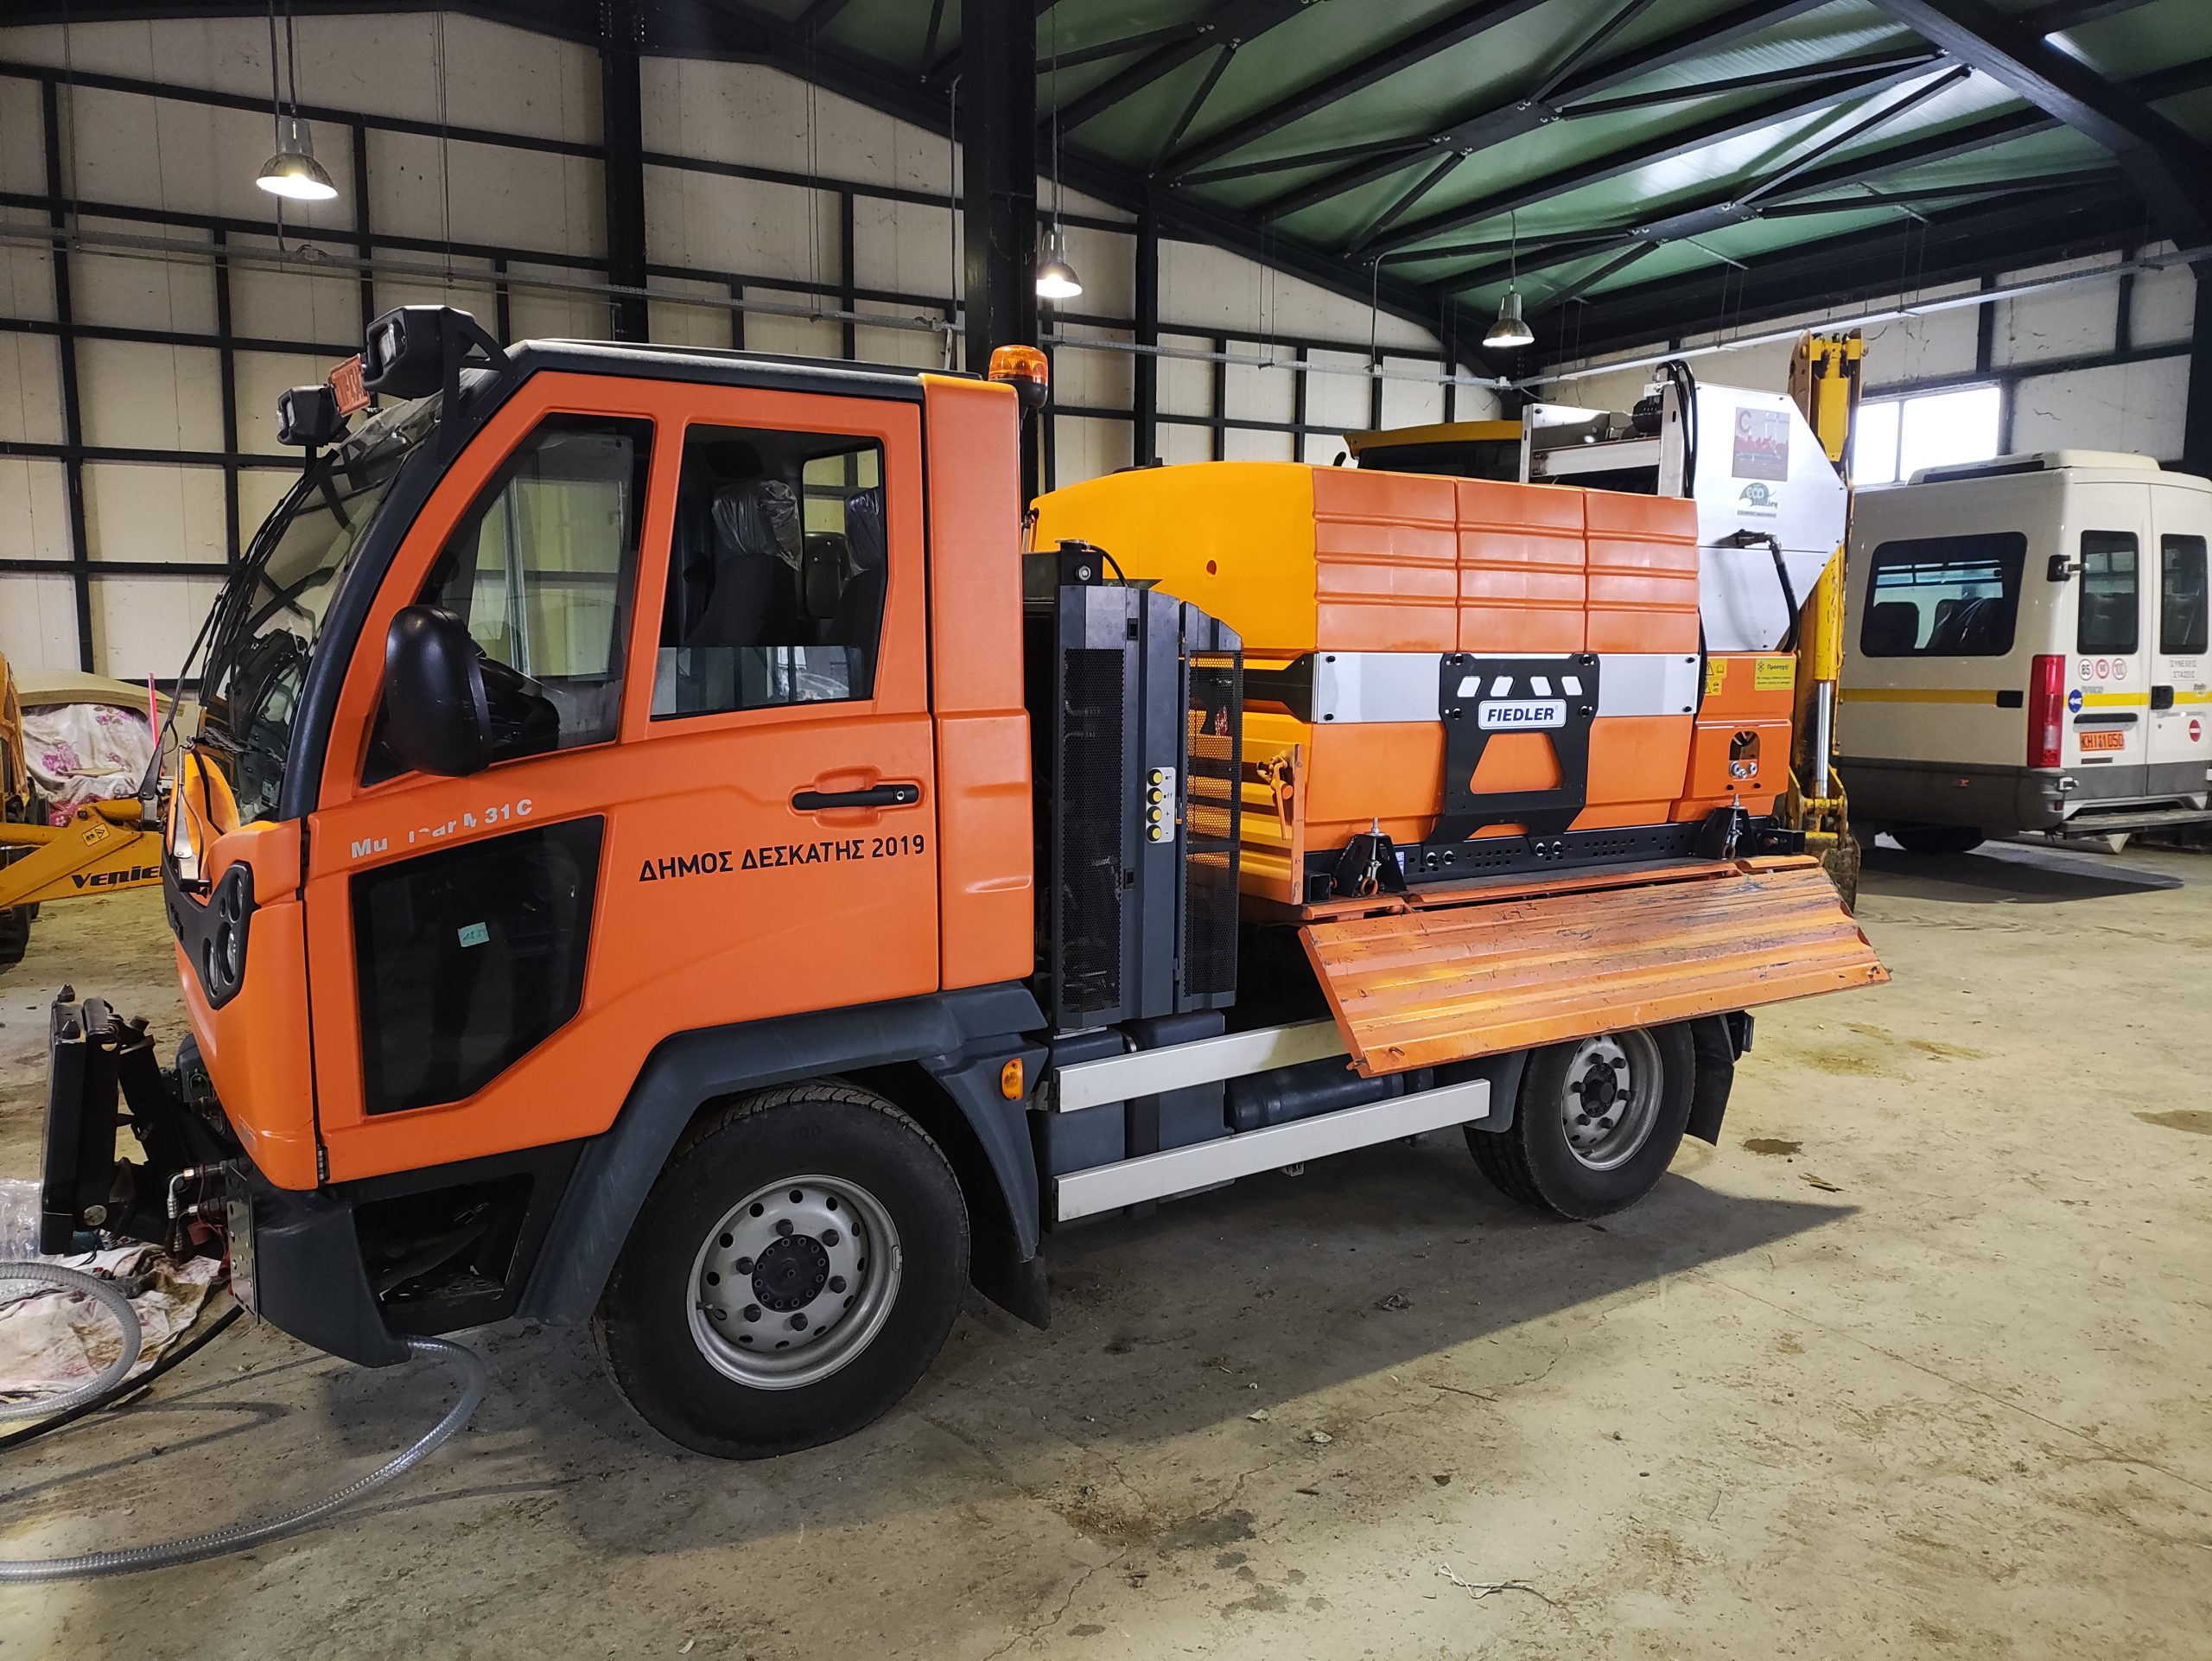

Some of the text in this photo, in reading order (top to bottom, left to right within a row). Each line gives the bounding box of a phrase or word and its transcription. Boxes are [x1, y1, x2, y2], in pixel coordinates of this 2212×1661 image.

[1487, 707, 1554, 722] FIEDLER
[639, 834, 925, 882] ΔΗΜΟΣ ΔΕΣΚΑΤΗΣ 2019
